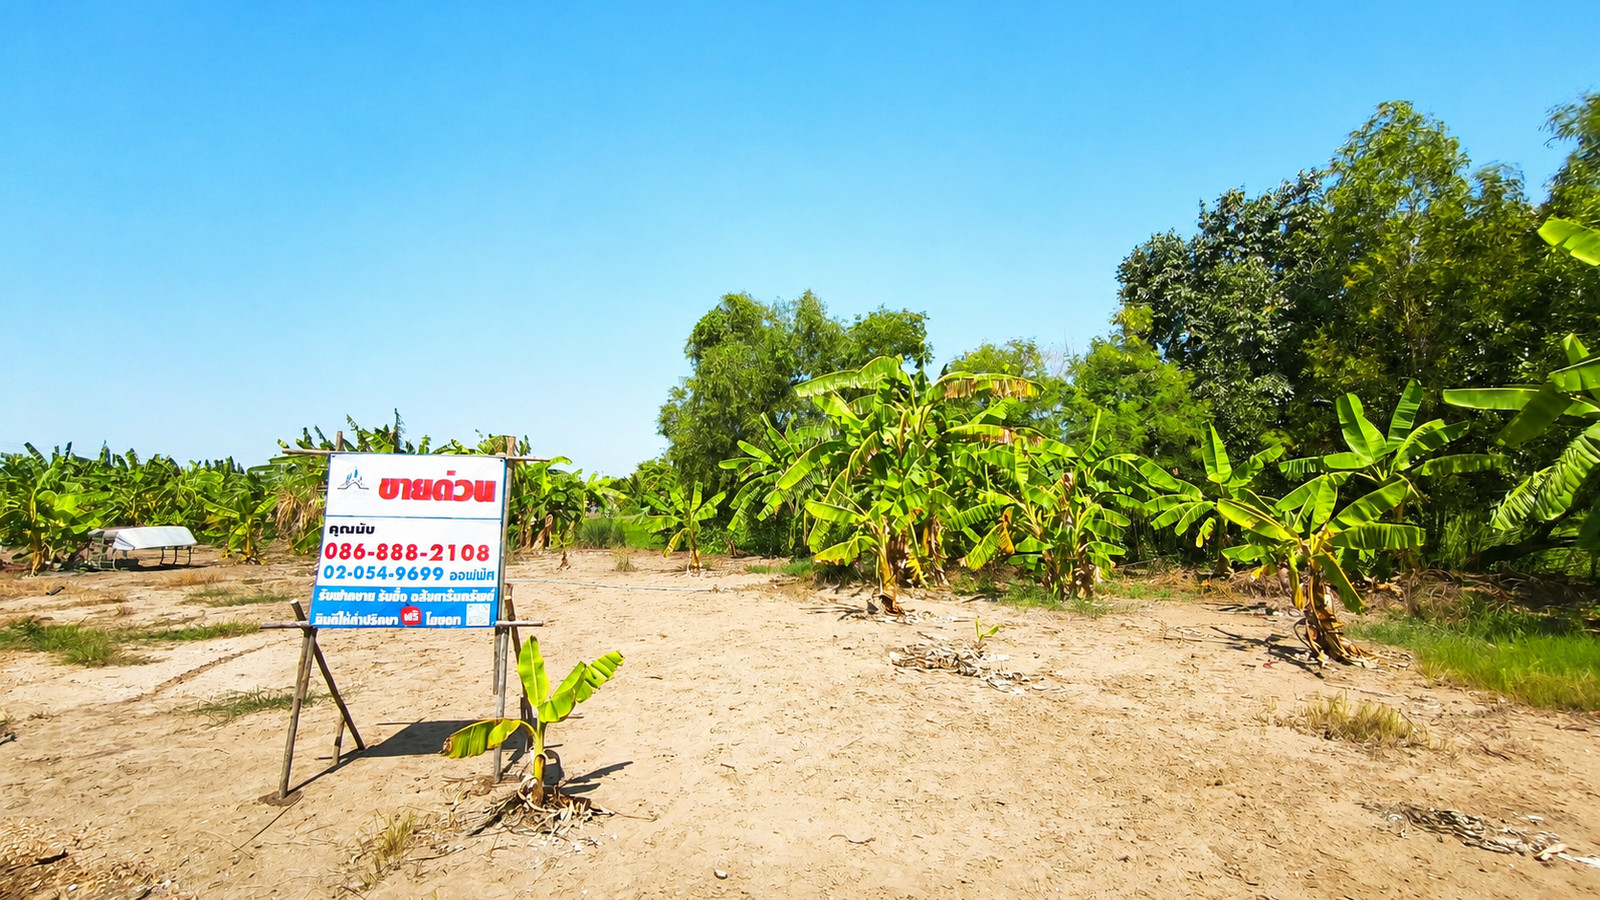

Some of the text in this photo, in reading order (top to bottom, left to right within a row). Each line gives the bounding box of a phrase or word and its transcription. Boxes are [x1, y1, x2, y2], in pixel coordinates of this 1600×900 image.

[378, 470, 497, 502] ขายด่วน
[324, 542, 490, 562] 086-888-2108
[323, 565, 495, 581] 02-054-9699 ออฟฟิศ
[318, 588, 376, 602] รับฝากขาย
[410, 588, 495, 602] อสังหาริมทรัพย์
